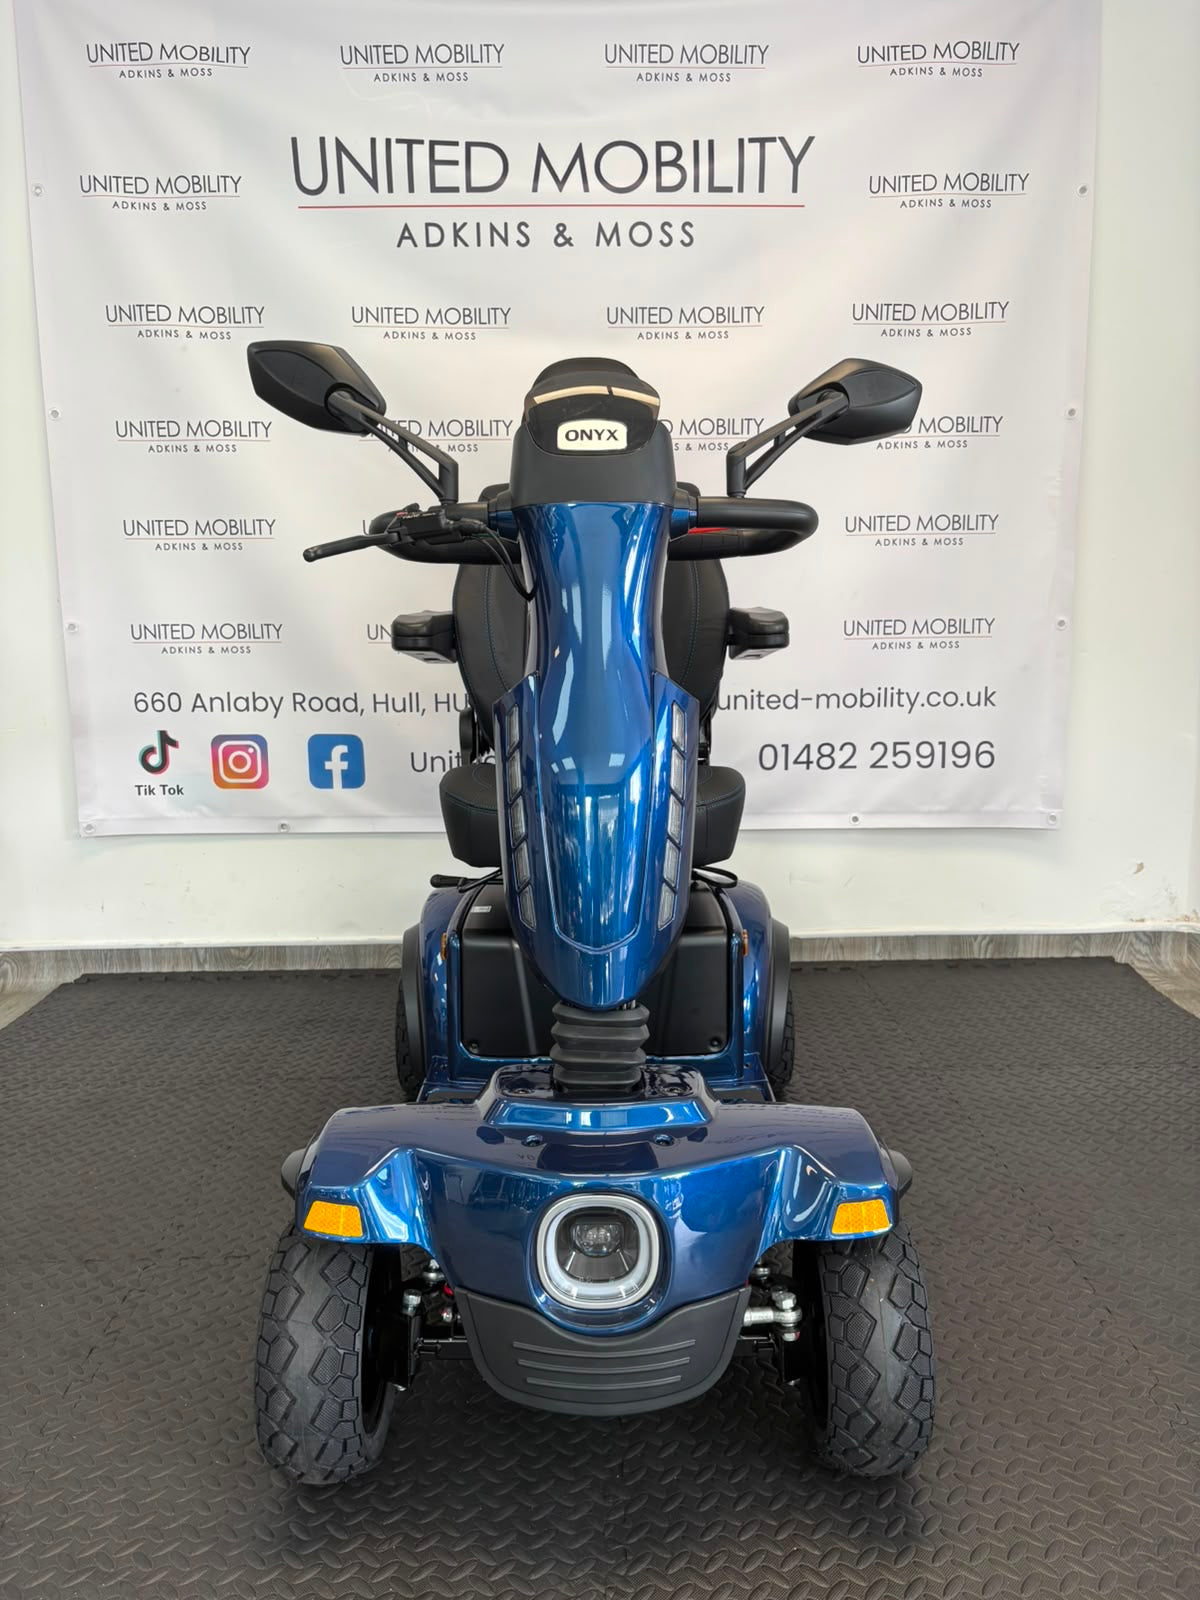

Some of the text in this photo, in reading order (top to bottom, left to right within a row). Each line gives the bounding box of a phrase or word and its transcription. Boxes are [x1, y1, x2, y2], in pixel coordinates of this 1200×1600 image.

[85, 41, 252, 66] UNITED MOBILITY
[339, 43, 505, 66] UNITED MOBILITY
[604, 43, 770, 65] UNITED MOBILITY
[857, 40, 1021, 65] UNITED MOBILITY
[118, 66, 213, 79] ADKINS & MOSS
[373, 71, 469, 83] ADKINS & MOSS
[635, 71, 732, 83] ADKINS & MOSS
[889, 65, 983, 78] ADKINS & MOSS
[290, 135, 816, 197] UNITED MOBILITY
[79, 174, 243, 195] UNITED MOBILITY
[868, 171, 1030, 195] UNITED MOBILITY
[111, 200, 207, 212] ADKINS & MOSS
[899, 197, 992, 209] ADKINS & MOSS
[396, 220, 695, 248] ADKINS & MOSS
[105, 303, 265, 325] UNITED MOBILITY
[351, 305, 512, 326] UNITED MOBILITY
[606, 305, 766, 326] UNITED MOBILITY
[852, 300, 1010, 322] UNITED MOBILITY
[136, 328, 232, 341] ADKINS & MOSS
[383, 330, 477, 341] ADKINS & MOSS
[636, 330, 729, 341] ADKINS & MOSS
[880, 326, 972, 338] ADKINS & MOSS
[115, 419, 273, 439] UNITED MOBILITY
[427, 418, 514, 438] MOBILITY
[679, 417, 765, 437] MOBILITY
[917, 415, 1004, 435] MOBILITY
[564, 428, 619, 443] ONYX
[875, 439, 968, 450] ADKINS & MOSS
[147, 443, 237, 454] ADKINS & MOSS
[447, 443, 479, 453] MOSS
[684, 442, 693, 452] &
[697, 441, 729, 452] MOSS
[122, 518, 276, 538] UNITED MOBILITY
[844, 513, 1000, 534] UNITED MOBILITY
[154, 541, 243, 552] ADKINS & MOSS
[874, 537, 964, 547] ADKINS & MOSS
[130, 622, 283, 641] UNITED MOBILITY
[843, 617, 996, 638] UNITED MOBILITY
[161, 645, 252, 655] ADKINS & MOSS
[871, 640, 960, 651] ADKINS & MOSS
[133, 691, 183, 714] 660
[190, 690, 285, 720] Anlaby
[291, 691, 365, 717] Road,
[372, 691, 427, 717] Hull,
[410, 749, 463, 773] Unit
[758, 740, 996, 772] 01482 259196
[133, 783, 185, 797] Tik Tok
